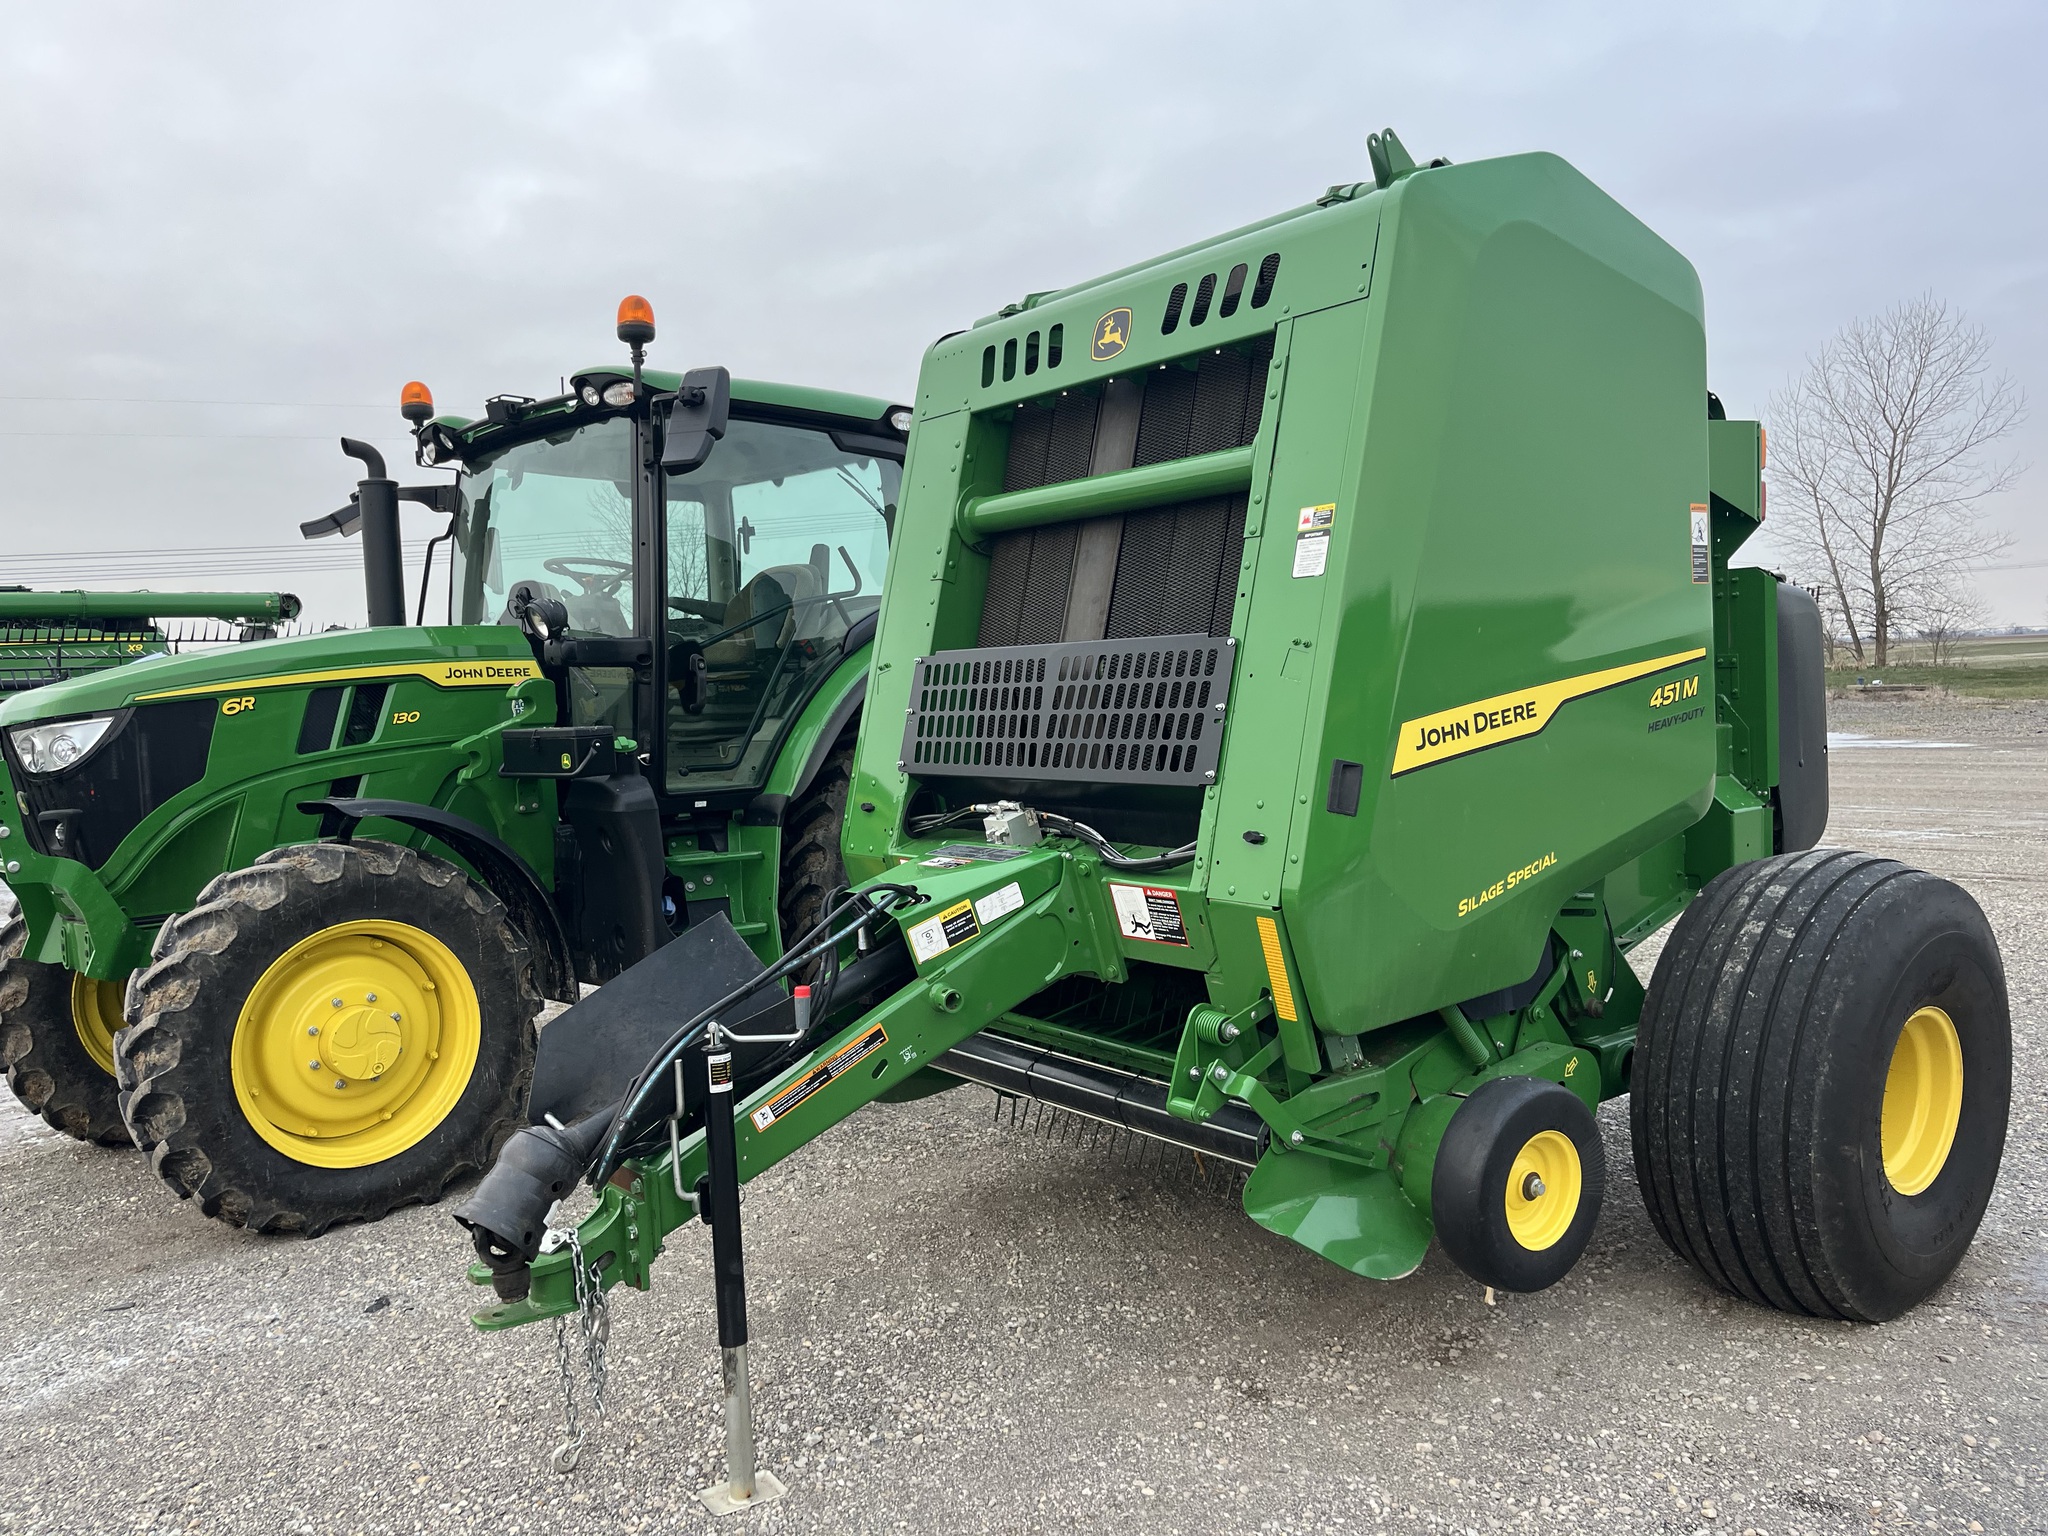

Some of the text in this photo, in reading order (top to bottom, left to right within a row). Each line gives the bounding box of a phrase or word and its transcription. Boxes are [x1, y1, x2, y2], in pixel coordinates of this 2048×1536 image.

[128, 643, 144, 652] X9
[445, 667, 531, 679] JOHN DEERE
[222, 696, 256, 716] 6R
[392, 711, 421, 725] 130
[1647, 706, 1706, 734] HEAVY-DUTY
[1416, 701, 1537, 751] JOHN DEERE
[1458, 851, 1558, 918] SILAGE SPECIAL
[1152, 890, 1173, 898] DANGER
[947, 904, 968, 917] CAUTION
[816, 1055, 838, 1071] WARNING
